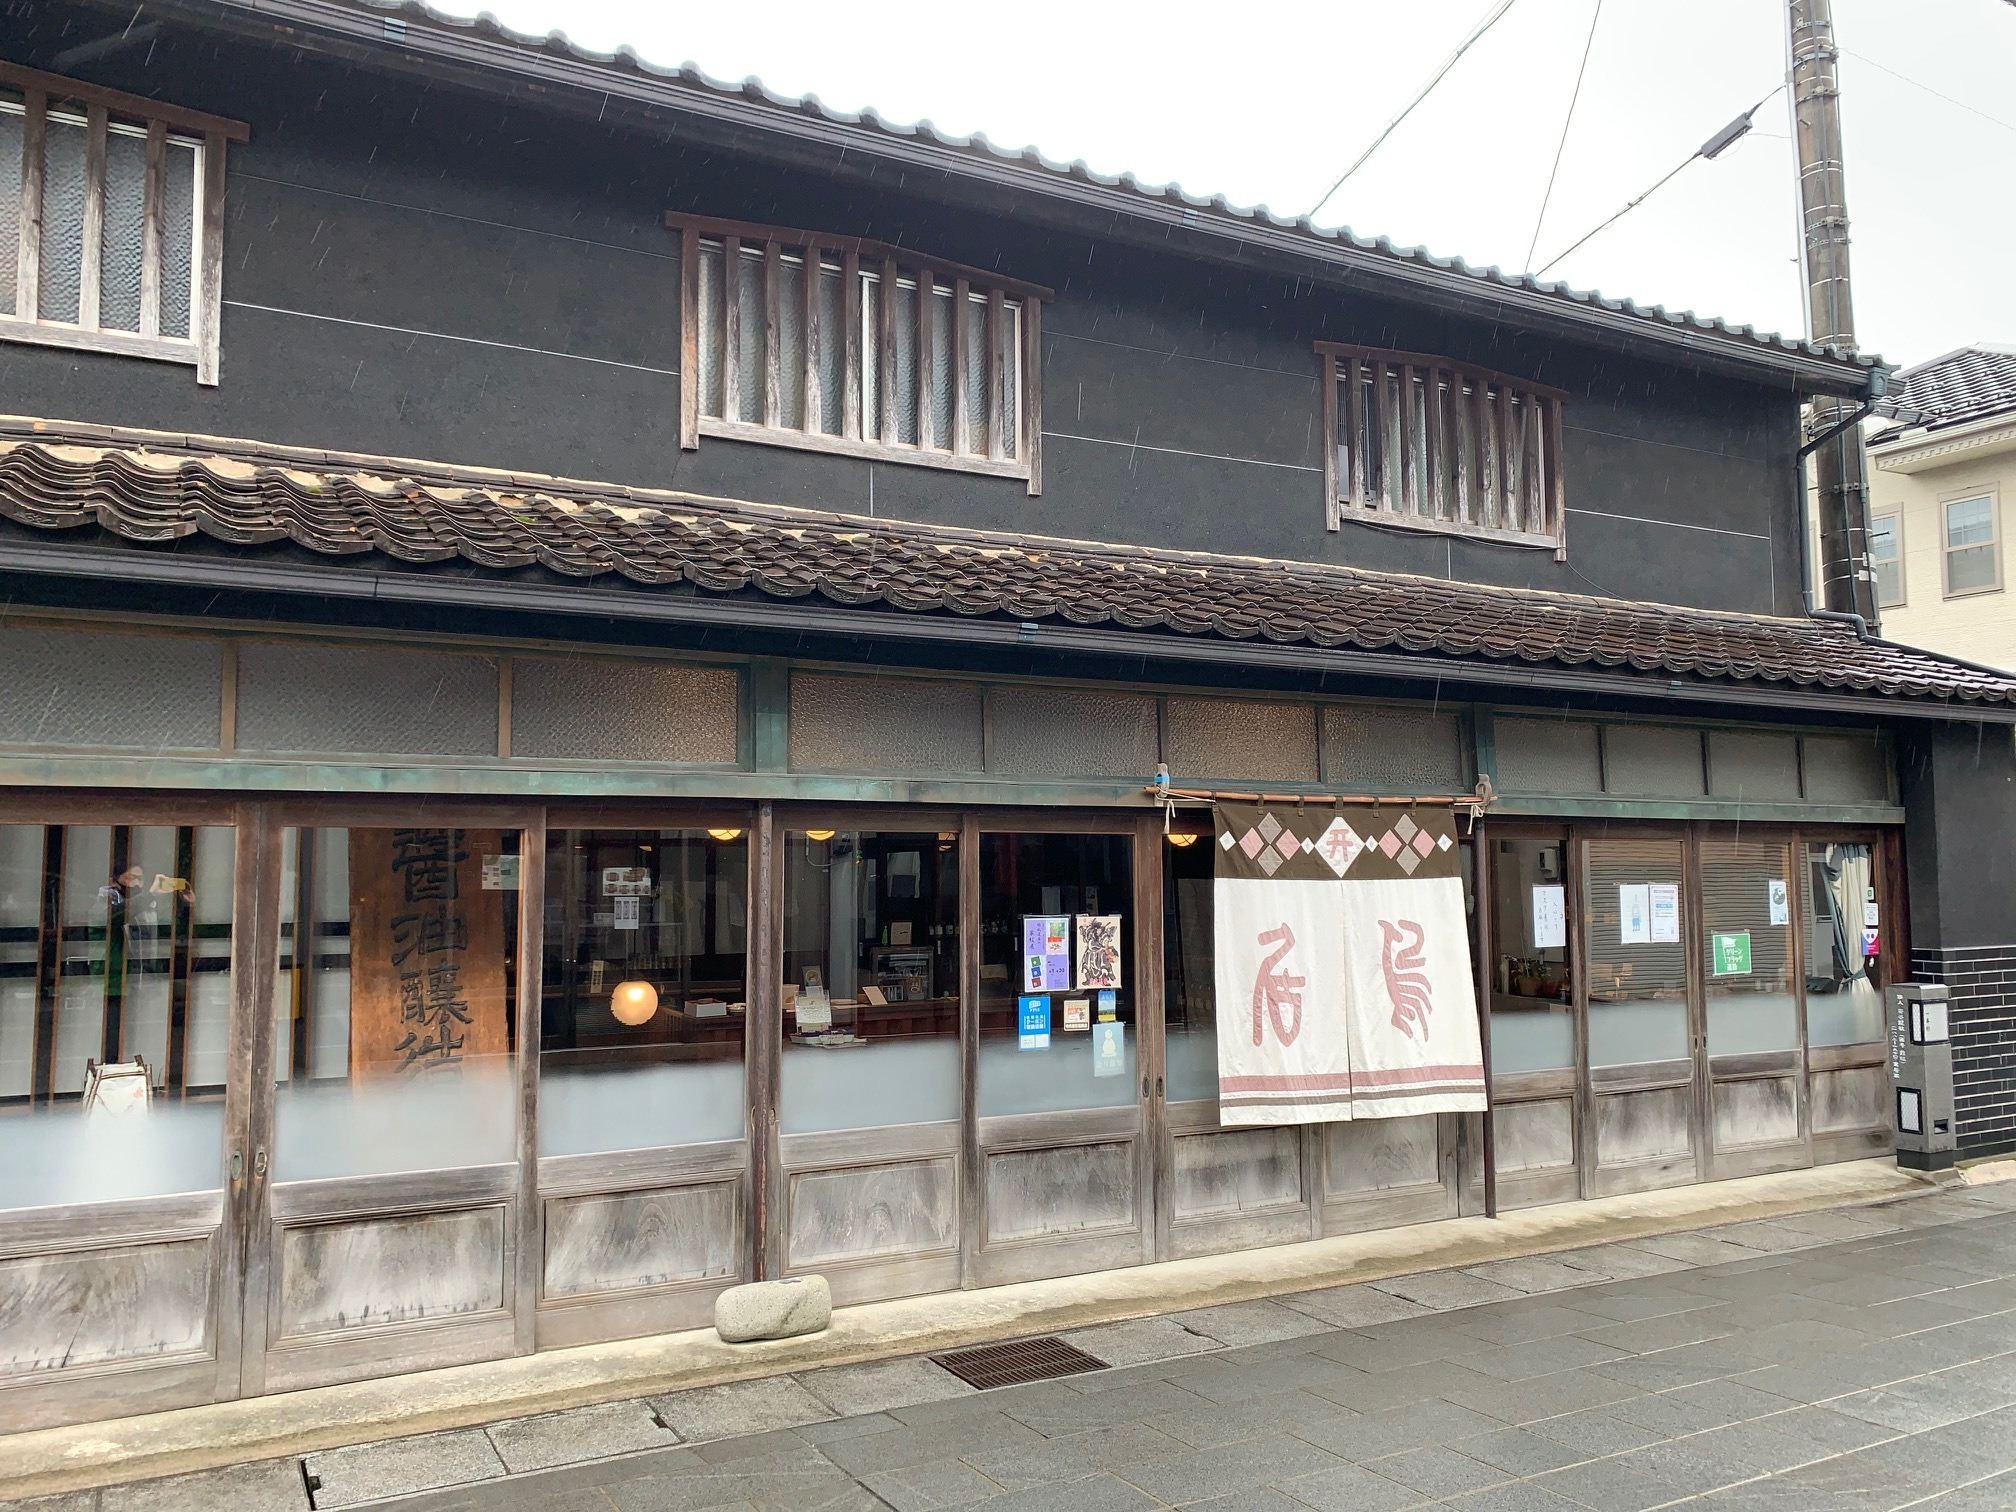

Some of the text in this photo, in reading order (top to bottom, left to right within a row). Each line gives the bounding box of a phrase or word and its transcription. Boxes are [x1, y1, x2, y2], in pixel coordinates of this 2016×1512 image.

[1726, 948, 1743, 956] グリーン
[1726, 955, 1744, 963] フラッグ
